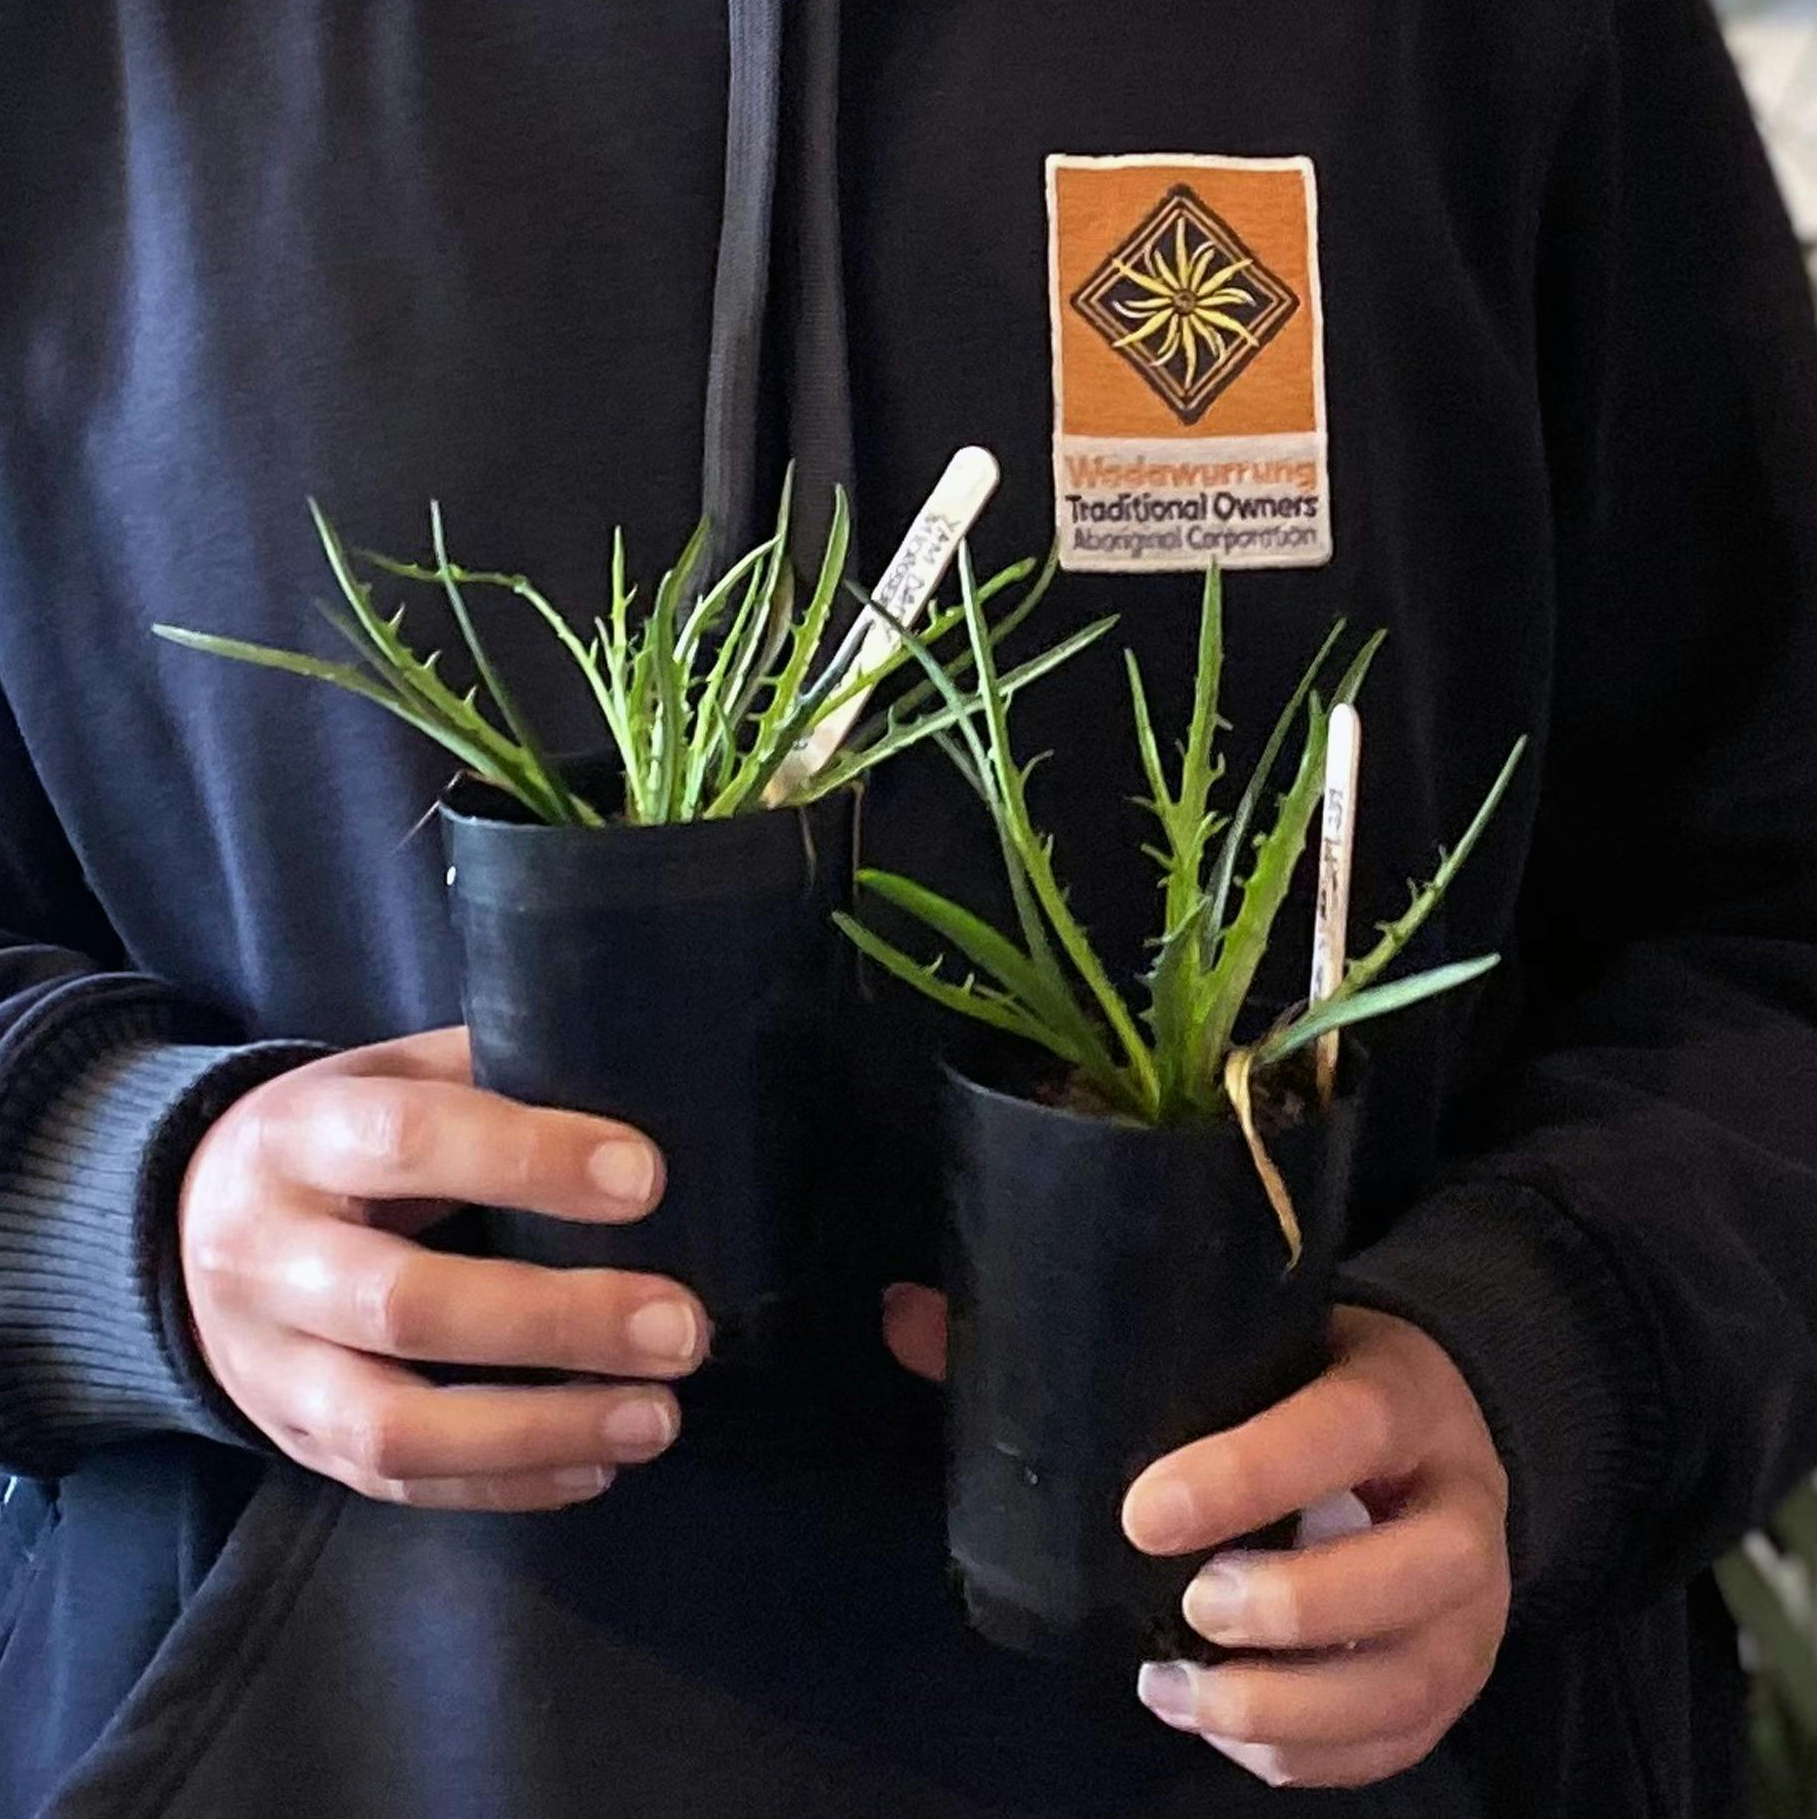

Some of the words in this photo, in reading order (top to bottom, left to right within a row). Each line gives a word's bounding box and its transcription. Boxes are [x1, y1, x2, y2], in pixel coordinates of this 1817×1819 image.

[1065, 492, 1206, 523] Traditional
[1213, 491, 1318, 521] Owners
[1073, 526, 1182, 557] Aboriginal
[1186, 525, 1318, 554] Corporation
